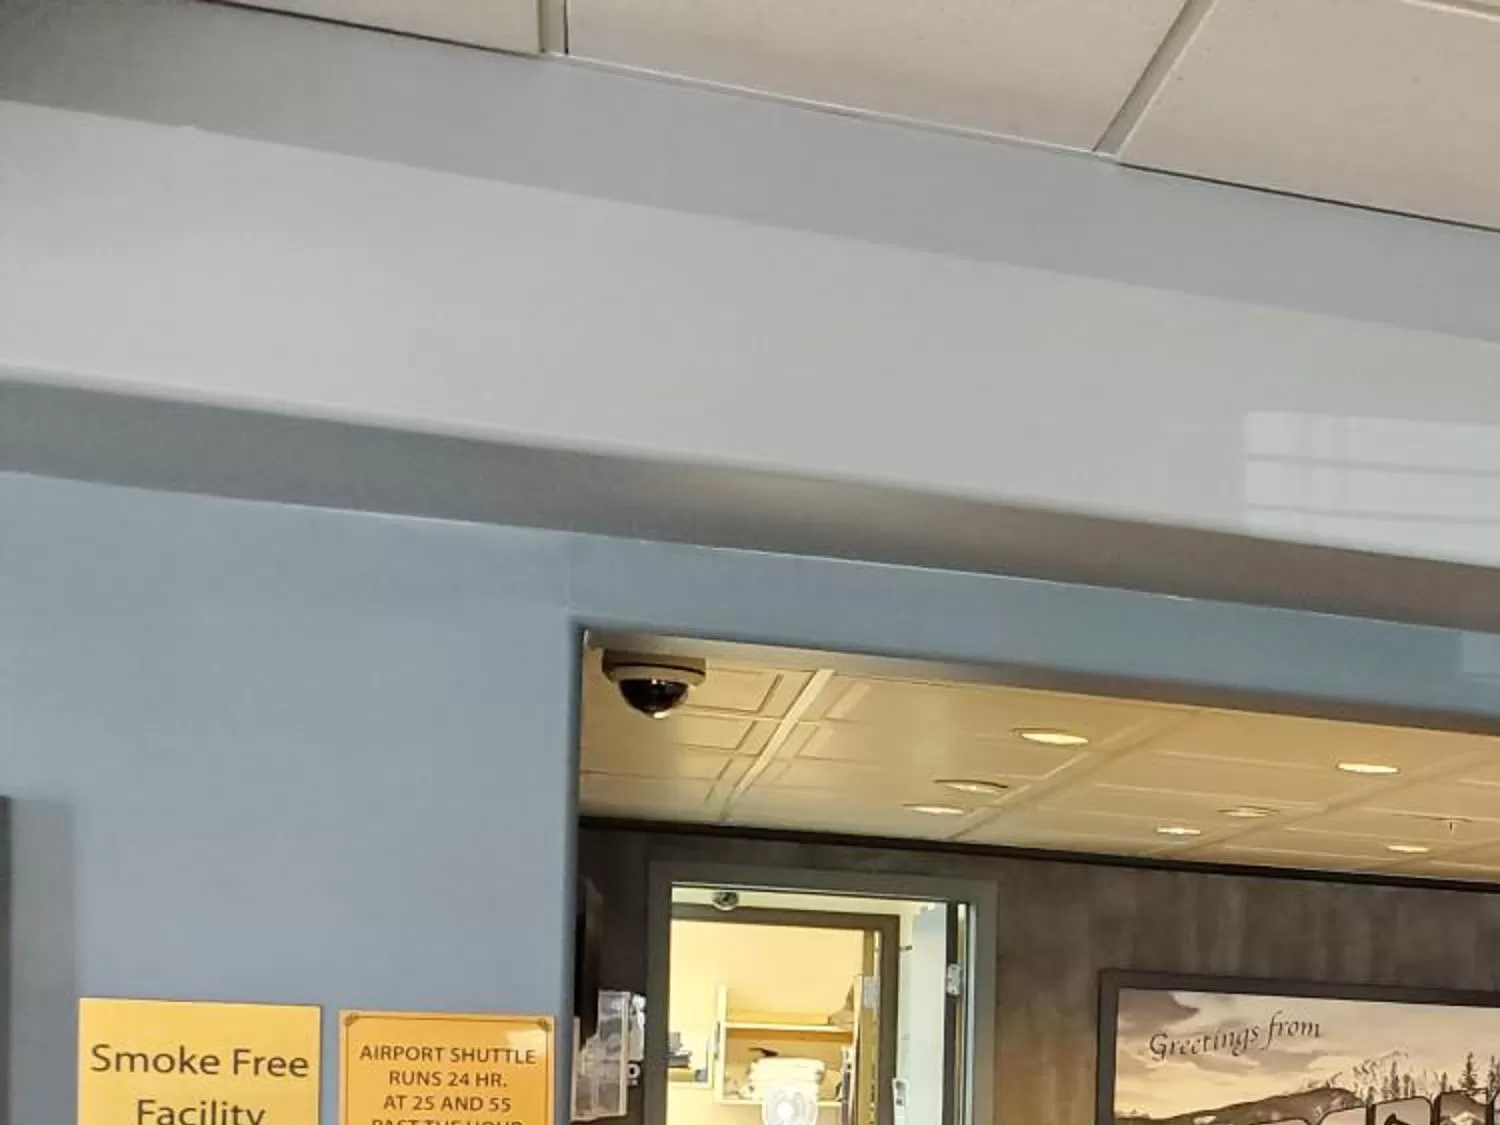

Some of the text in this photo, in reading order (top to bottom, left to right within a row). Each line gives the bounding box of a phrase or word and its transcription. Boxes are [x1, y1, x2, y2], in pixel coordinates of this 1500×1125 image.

[1149, 1010, 1320, 1060] Greetings from
[90, 1043, 310, 1078] Smoke Free
[359, 1044, 538, 1065] AIRPORT SHUTTLE
[388, 1069, 508, 1089] RUNS 24 HR.
[383, 1094, 512, 1113] AT 25 AND 55
